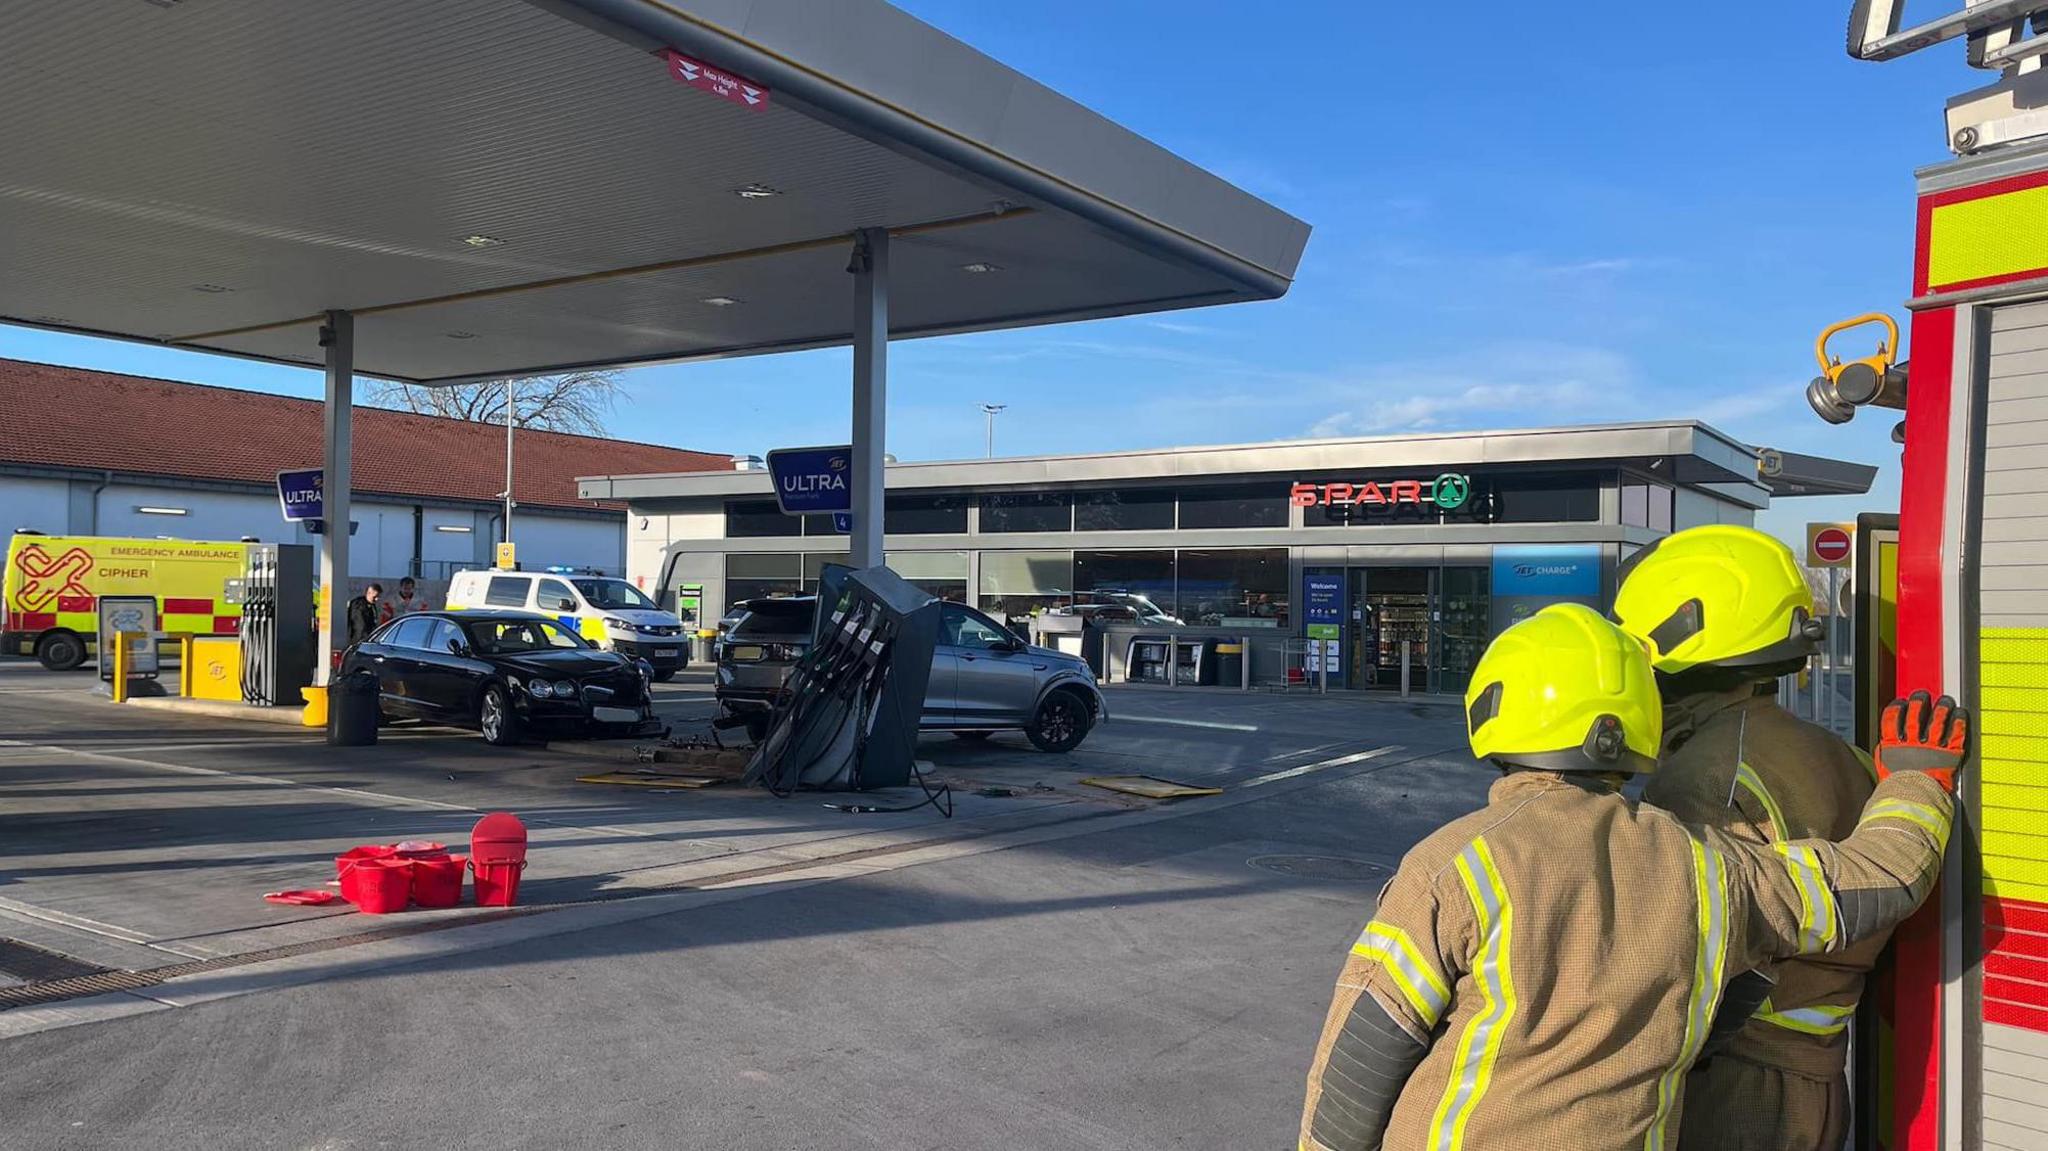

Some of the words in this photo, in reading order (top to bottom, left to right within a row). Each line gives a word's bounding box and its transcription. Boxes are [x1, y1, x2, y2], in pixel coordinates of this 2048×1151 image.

[703, 68, 717, 81] Max
[717, 74, 738, 90] Height
[784, 474, 845, 491] ULTRA
[286, 490, 322, 503] ULTRA
[1291, 480, 1421, 506] SPAR
[310, 521, 316, 531] 2
[840, 517, 847, 528] 4
[111, 547, 175, 557] EMERGENCY
[178, 549, 240, 559] AMBULANCE
[99, 568, 149, 578] CIPHER
[1536, 566, 1571, 575] CHARGE
